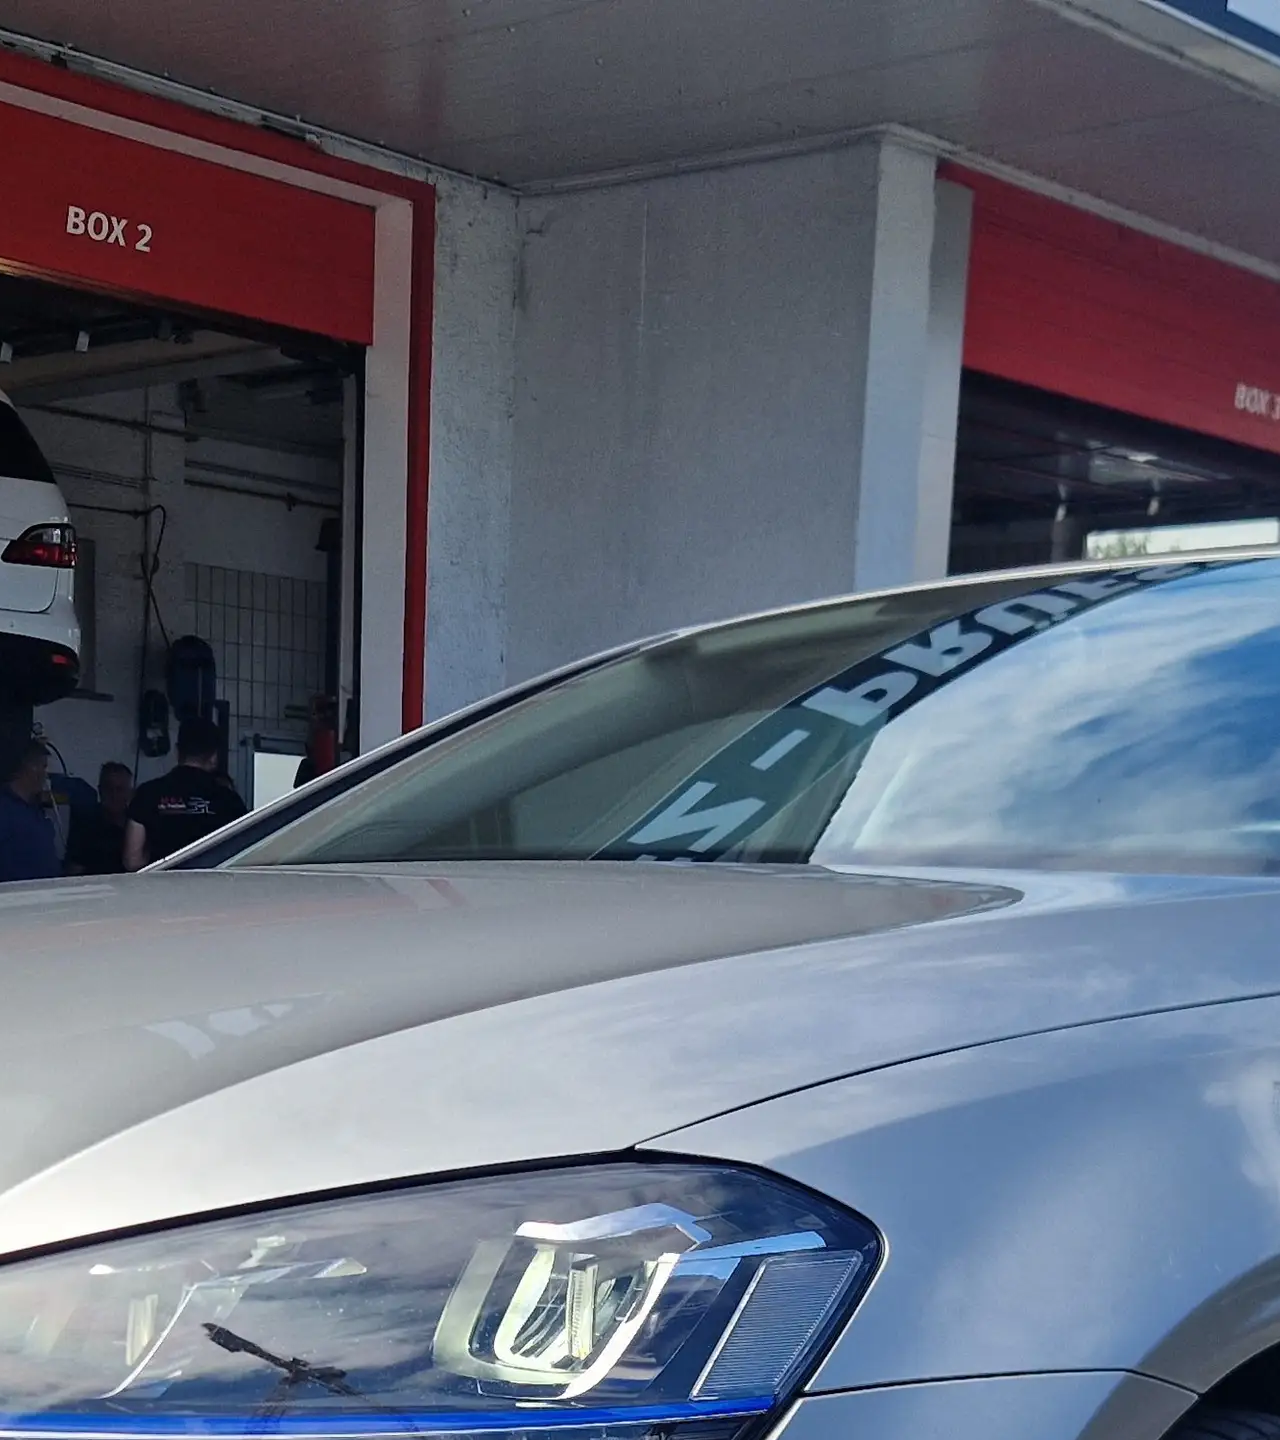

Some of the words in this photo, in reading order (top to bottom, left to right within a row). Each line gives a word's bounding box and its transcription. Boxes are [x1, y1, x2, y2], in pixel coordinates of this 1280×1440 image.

[66, 205, 128, 248] BOX
[135, 223, 152, 252] 2
[1234, 383, 1270, 416] BOX
